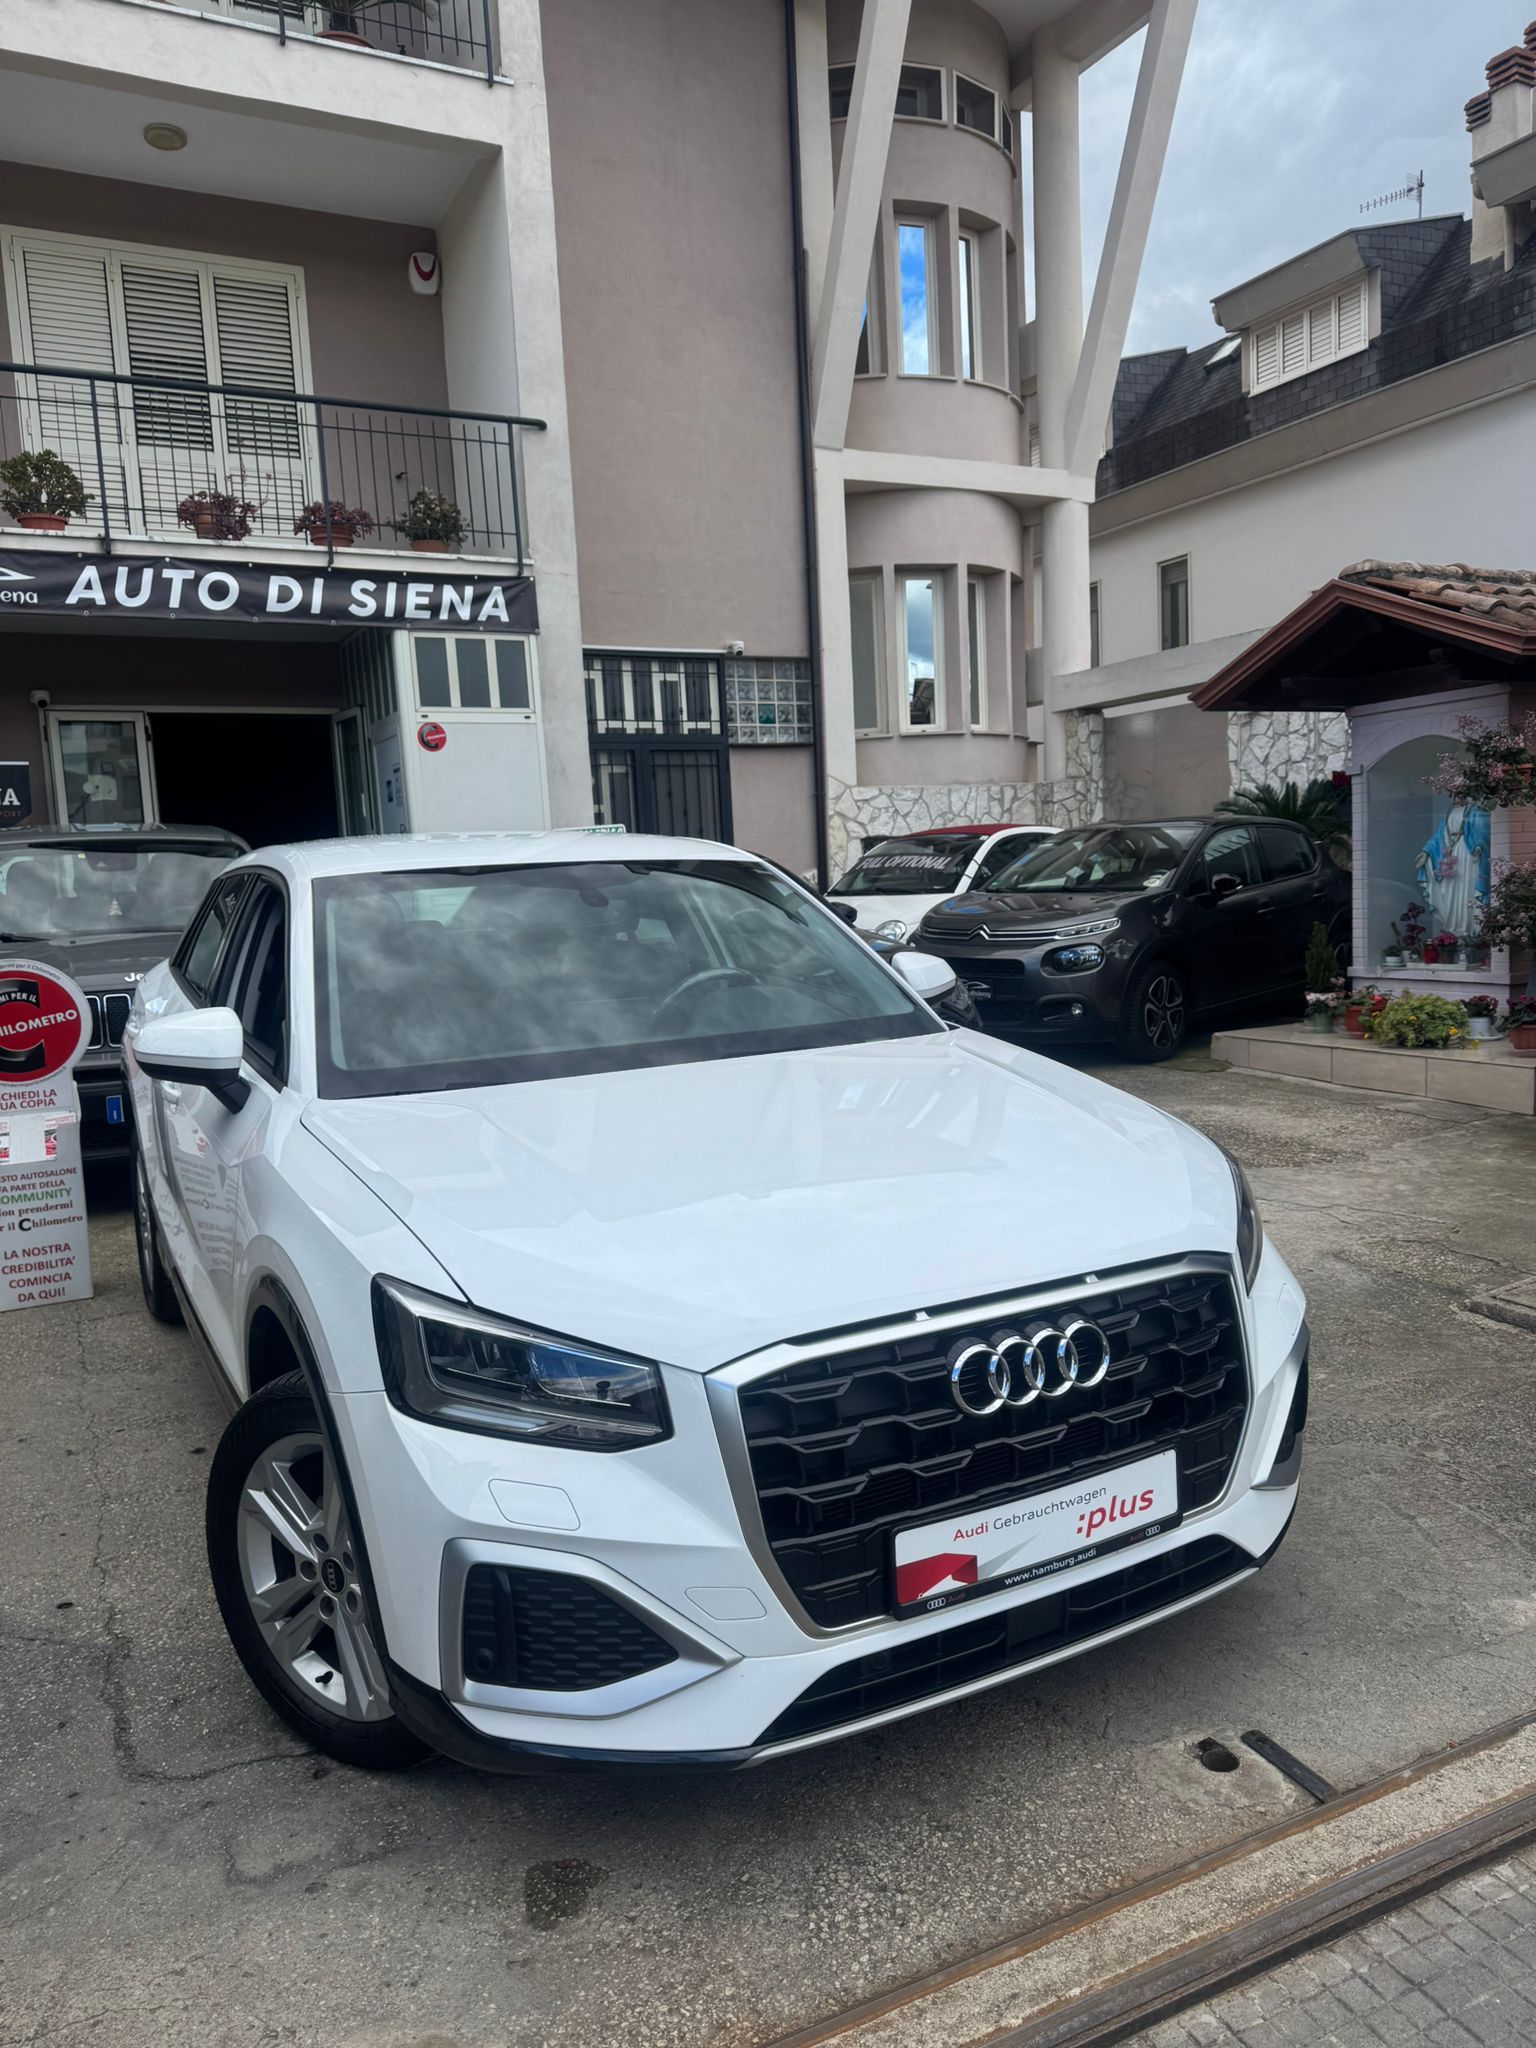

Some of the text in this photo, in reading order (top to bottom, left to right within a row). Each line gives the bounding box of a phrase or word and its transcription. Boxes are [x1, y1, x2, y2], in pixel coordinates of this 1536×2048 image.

[0, 590, 38, 605] ena
[65, 565, 510, 622] AUTO DI SIENA
[0, 787, 21, 806] A
[856, 855, 952, 870] FULL OPTIONAL
[124, 972, 145, 982] Je
[10, 992, 28, 1000] PER
[29, 994, 37, 1003] IL
[1, 1088, 57, 1101] CHIEDI LA
[0, 1098, 56, 1111] UA COPIA
[0, 1167, 78, 1183] STO AUTOSALONE
[10, 1182, 37, 1192] PARTE
[39, 1179, 65, 1189] DELLA
[0, 1187, 73, 1205] OMMUNITY
[0, 1200, 74, 1218] on prendermi
[8, 1221, 15, 1231] il
[18, 1215, 84, 1232] Chilometro
[4, 1242, 72, 1260] LA NOSTRA
[9, 1272, 72, 1289] COMINCIA
[18, 1287, 66, 1303] DA QUI!
[953, 1487, 1107, 1542] Audi Gebrauchtwagen
[1076, 1489, 1154, 1538] :plus
[1004, 1548, 1097, 1585] www.hamburg.audi
